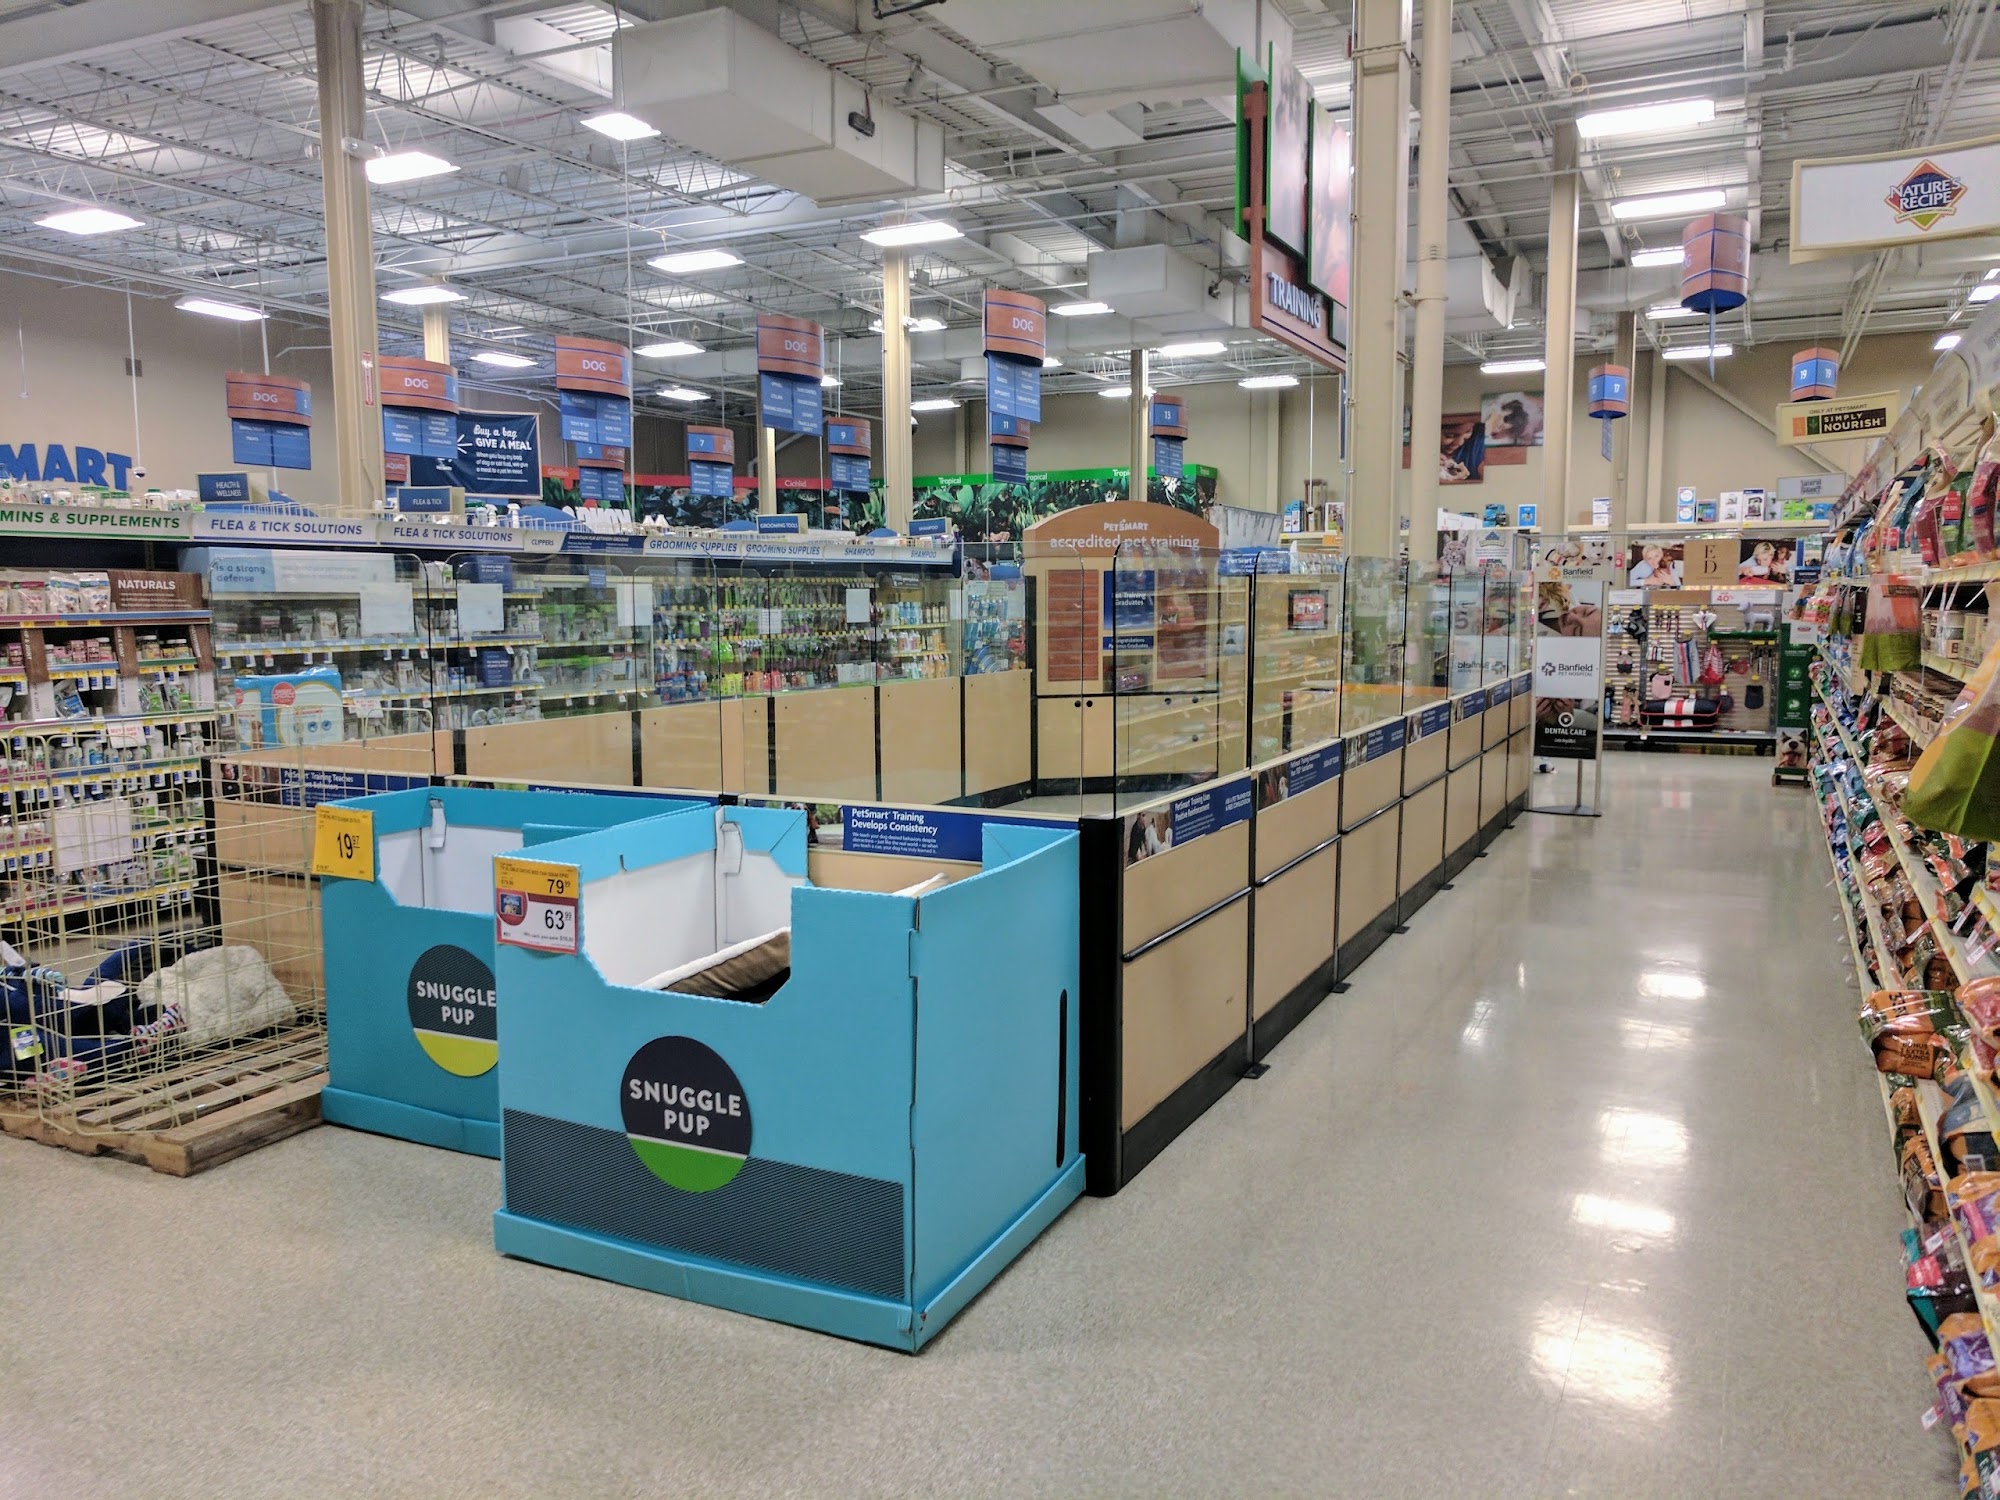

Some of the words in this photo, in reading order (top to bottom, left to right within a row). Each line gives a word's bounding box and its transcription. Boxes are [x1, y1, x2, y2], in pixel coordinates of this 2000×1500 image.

[1890, 177, 1961, 198] NATURE'S
[1900, 191, 1952, 209] RECIPE
[1267, 271, 1320, 328] TRAINING
[1012, 317, 1034, 332] DOG
[784, 340, 807, 353] DOG
[582, 360, 606, 372] DOG
[1800, 370, 1807, 379] 19
[404, 377, 429, 389] DOG
[253, 392, 278, 403] DOG
[1834, 404, 1867, 412] PETSMART
[1164, 411, 1171, 420] 13
[1824, 413, 1862, 422] SIMPLY
[1003, 421, 1009, 429] 11
[1824, 418, 1881, 432] NOURISH
[473, 424, 491, 438] Buy
[502, 426, 517, 440] bag
[475, 438, 498, 448] GIVE
[499, 440, 507, 449] A
[508, 440, 532, 450] MEAL
[699, 439, 705, 447] 7
[785, 480, 807, 488] Cichlid
[938, 477, 961, 486] Tropical
[50, 513, 60, 524] &
[66, 513, 180, 529] SUPPLEMENTS
[211, 519, 244, 530] FLEA
[250, 521, 256, 531] &
[262, 521, 290, 532] TICK
[294, 522, 363, 535] SOLUTIONS
[1104, 519, 1148, 531] PETSMART
[394, 527, 419, 538] FLEA
[423, 530, 429, 539] &
[433, 529, 454, 540] TICK
[458, 531, 512, 542] SOLUTIONS
[650, 540, 698, 551] GROOMING
[700, 541, 737, 552] SUPPLIES
[1050, 534, 1118, 548] accredited
[1124, 536, 1147, 551] pet
[1151, 535, 1199, 551] training
[746, 544, 787, 554] GROOMING
[788, 545, 820, 556] SUPPLIES
[844, 547, 875, 556] SHAMPOO
[910, 549, 937, 559] SHAMPOO
[1705, 545, 1716, 558] E
[216, 562, 224, 571] is
[236, 563, 266, 574] strong
[1563, 568, 1593, 576] Banfield
[1704, 560, 1717, 573] D
[216, 573, 255, 582] defense
[118, 579, 176, 590] NATURALS
[1558, 664, 1593, 672] Banfield
[851, 808, 888, 820] PetSmart
[893, 810, 924, 825] Training
[851, 819, 888, 832] Develops
[889, 821, 938, 836] Consistency
[337, 832, 353, 859] 19
[547, 878, 564, 894] 79
[545, 909, 564, 930] 63
[416, 980, 497, 1008] SNUGGLE
[441, 1005, 475, 1026] PUP
[629, 1078, 742, 1117] SNUGGLE
[664, 1109, 710, 1137] PUP
